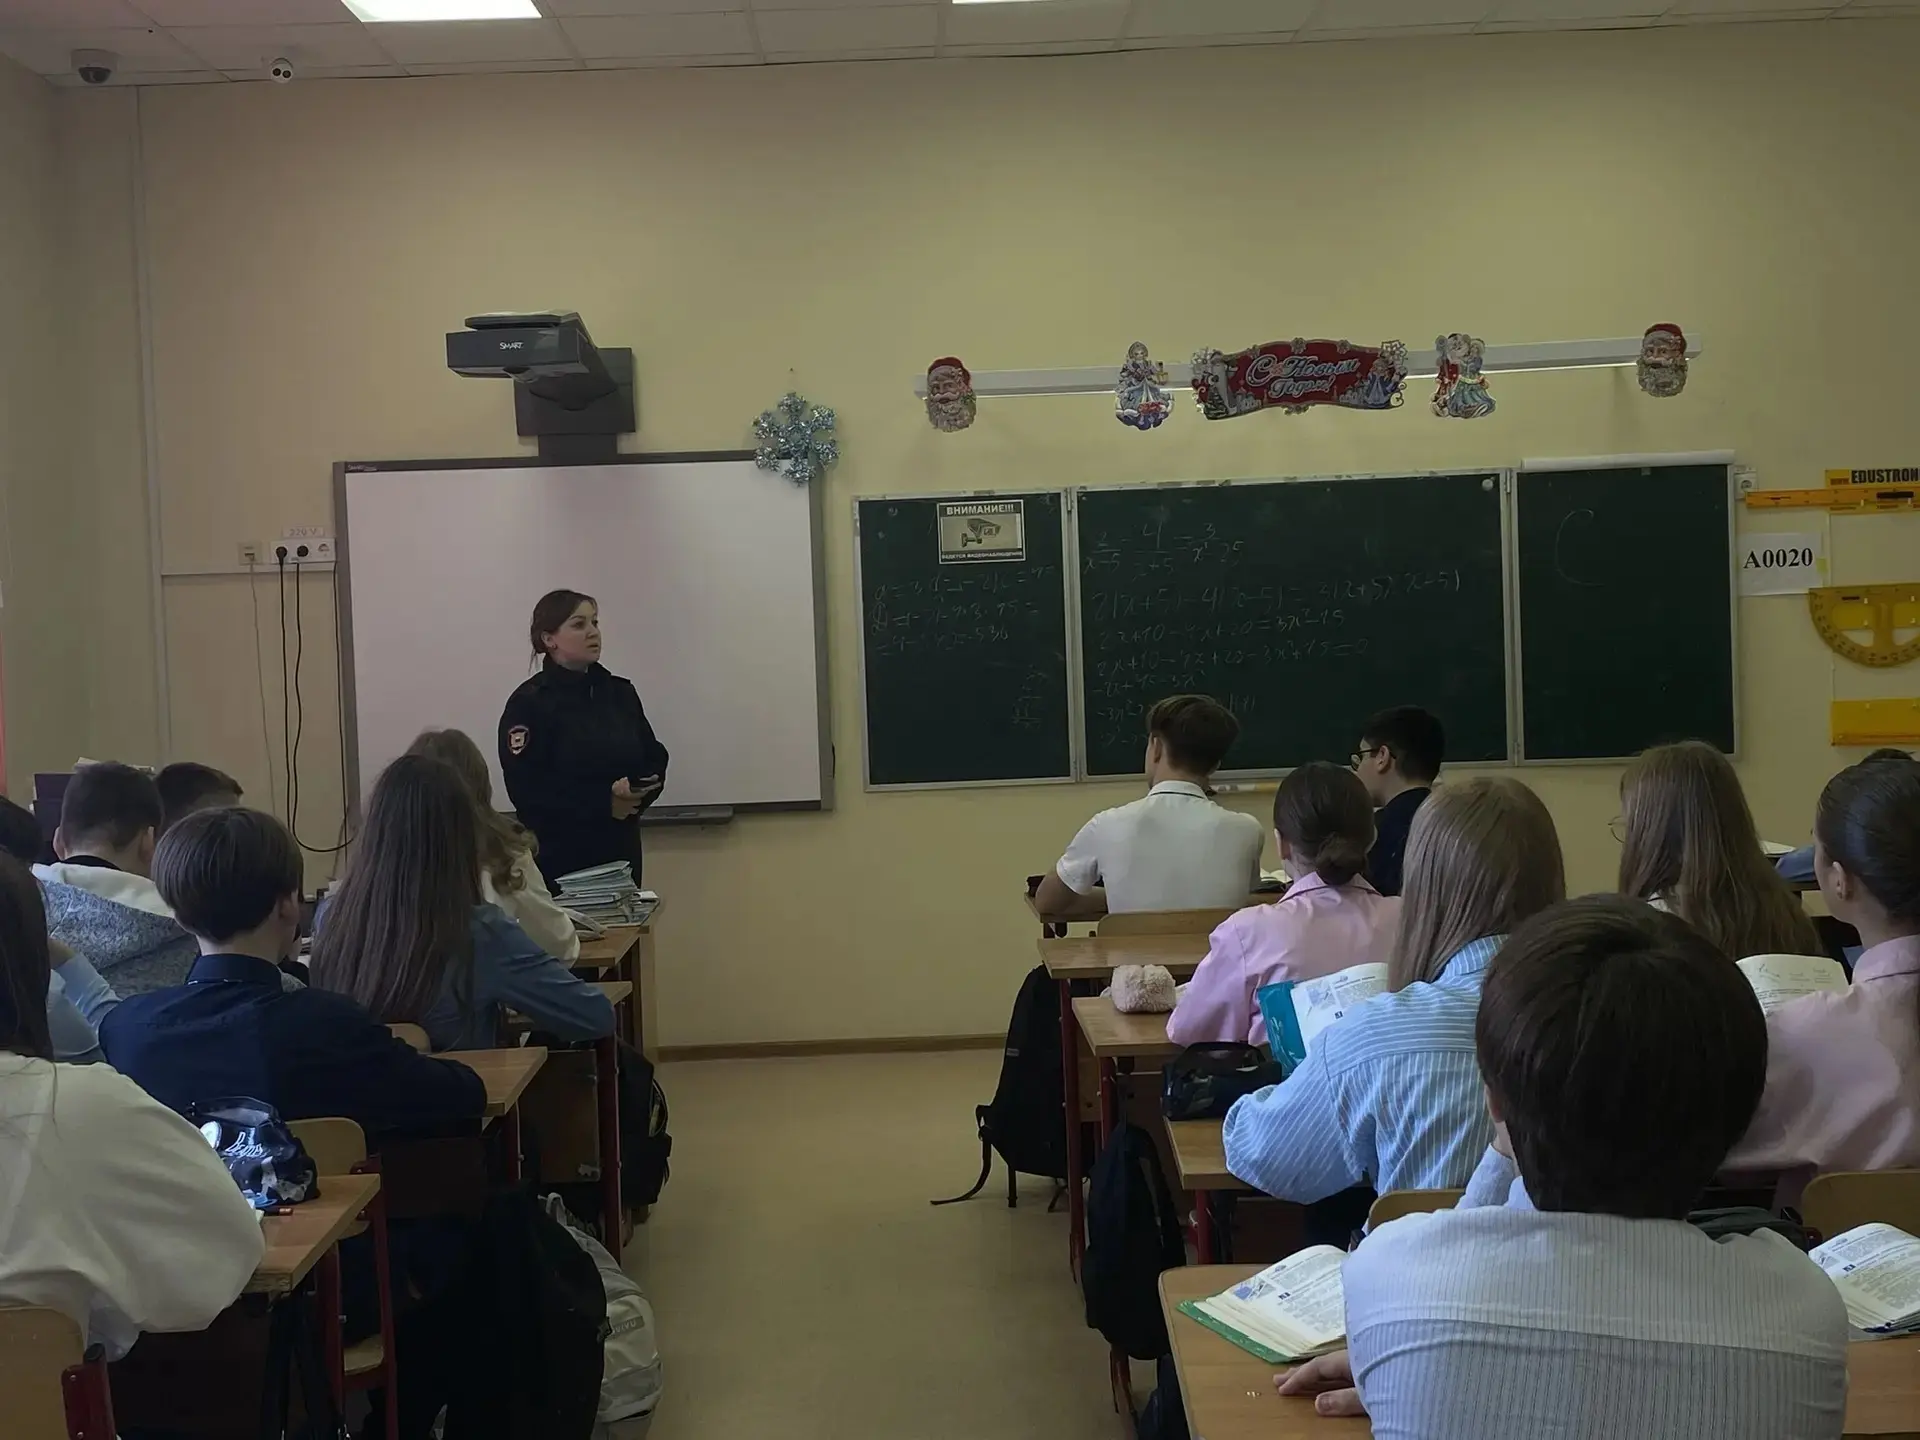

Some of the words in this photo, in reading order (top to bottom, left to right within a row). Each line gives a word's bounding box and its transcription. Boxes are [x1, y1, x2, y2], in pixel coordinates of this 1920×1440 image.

[499, 341, 524, 350] SMART
[1280, 355, 1361, 378] Новым
[946, 503, 1014, 516] ВНИМАНИЕ!!!
[1743, 548, 1814, 569] A0020
